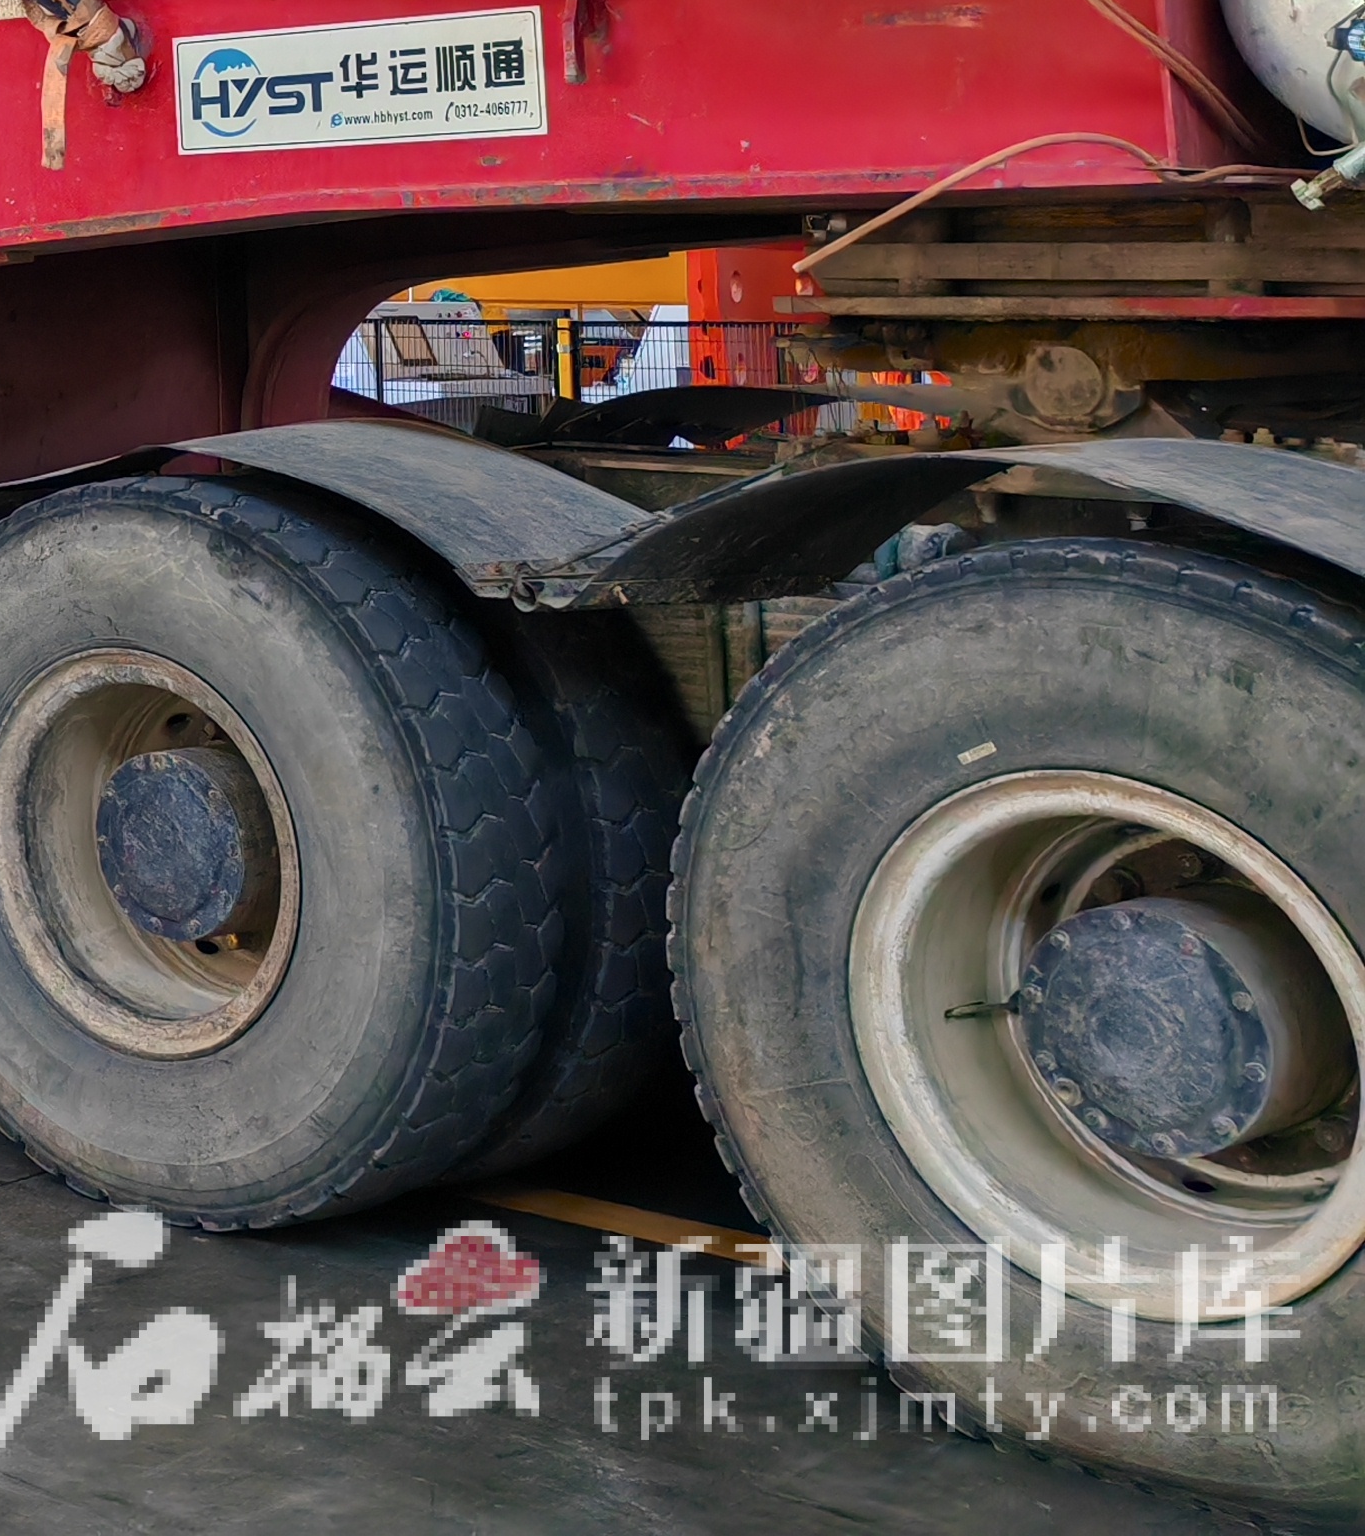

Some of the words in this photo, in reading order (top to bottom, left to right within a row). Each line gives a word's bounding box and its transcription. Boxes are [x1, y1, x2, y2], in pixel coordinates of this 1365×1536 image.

[339, 36, 527, 100] 华运顺通
[344, 109, 434, 126] www.hbhyst.com
